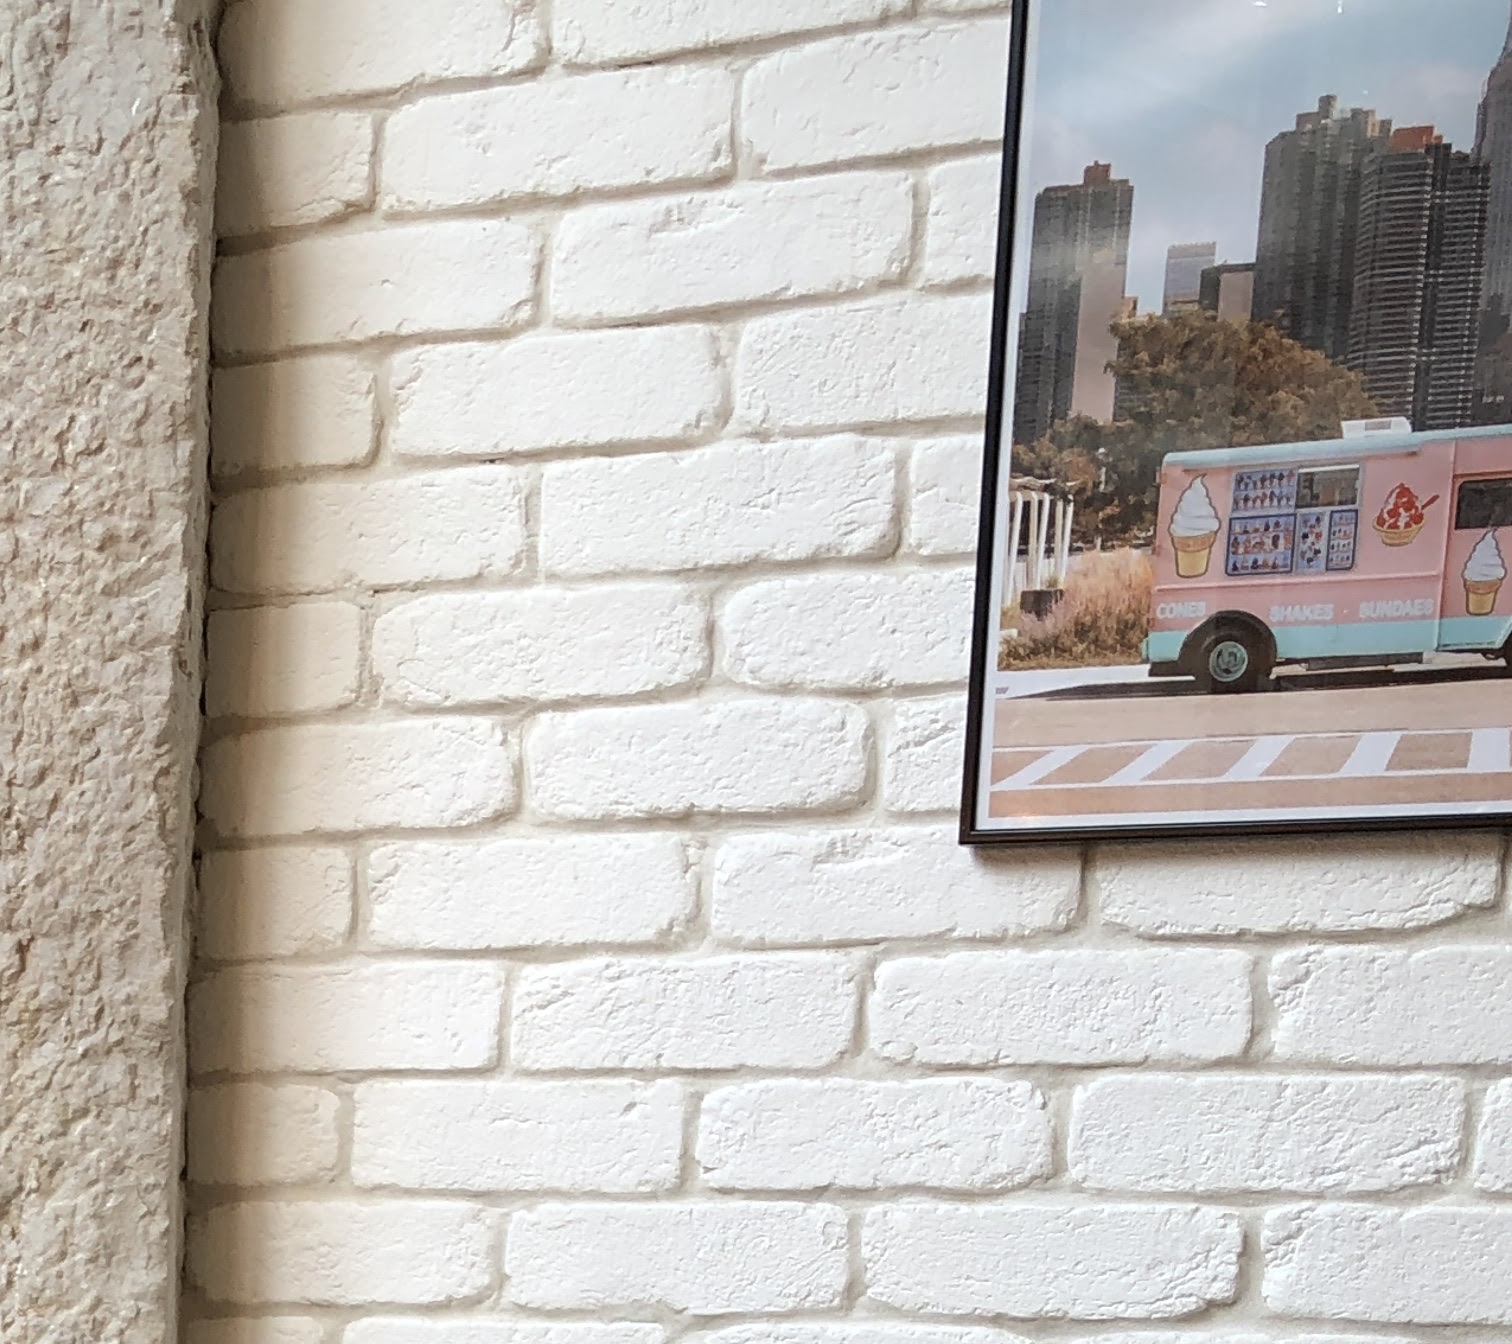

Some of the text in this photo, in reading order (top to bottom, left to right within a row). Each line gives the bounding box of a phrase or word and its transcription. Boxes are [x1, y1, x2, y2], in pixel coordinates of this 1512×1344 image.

[1156, 598, 1435, 622] CONES SHAKES SUNDAES
